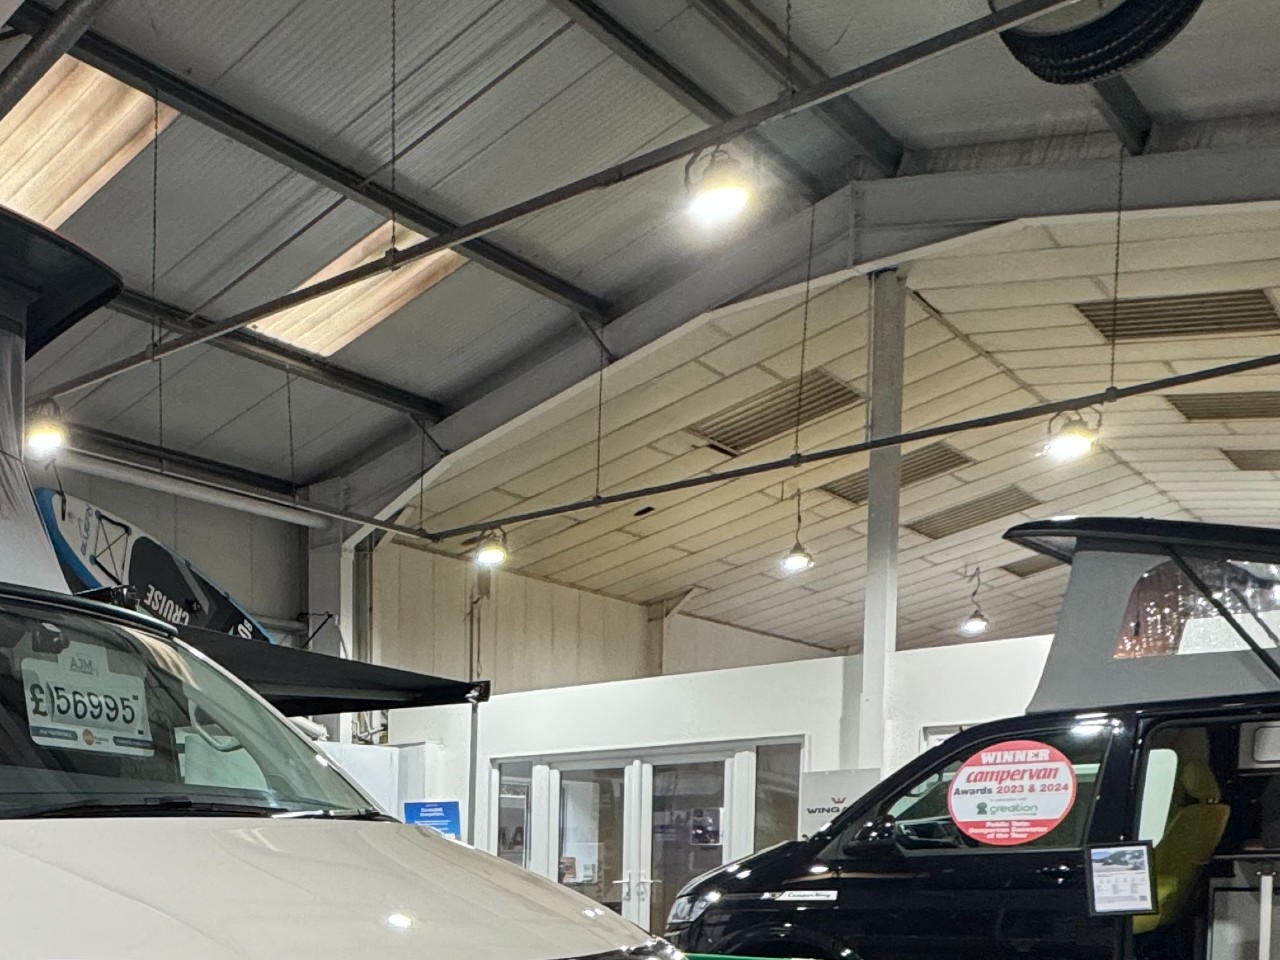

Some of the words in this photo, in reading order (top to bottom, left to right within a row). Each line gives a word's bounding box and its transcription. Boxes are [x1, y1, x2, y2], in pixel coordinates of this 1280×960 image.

[144, 584, 190, 625] CRUISE
[981, 749, 1050, 764] WINNER
[966, 767, 1060, 785] campervan
[954, 786, 993, 796] Awards
[996, 784, 1025, 794] 2023
[1028, 784, 1036, 793] &
[1039, 783, 1069, 792] 2024
